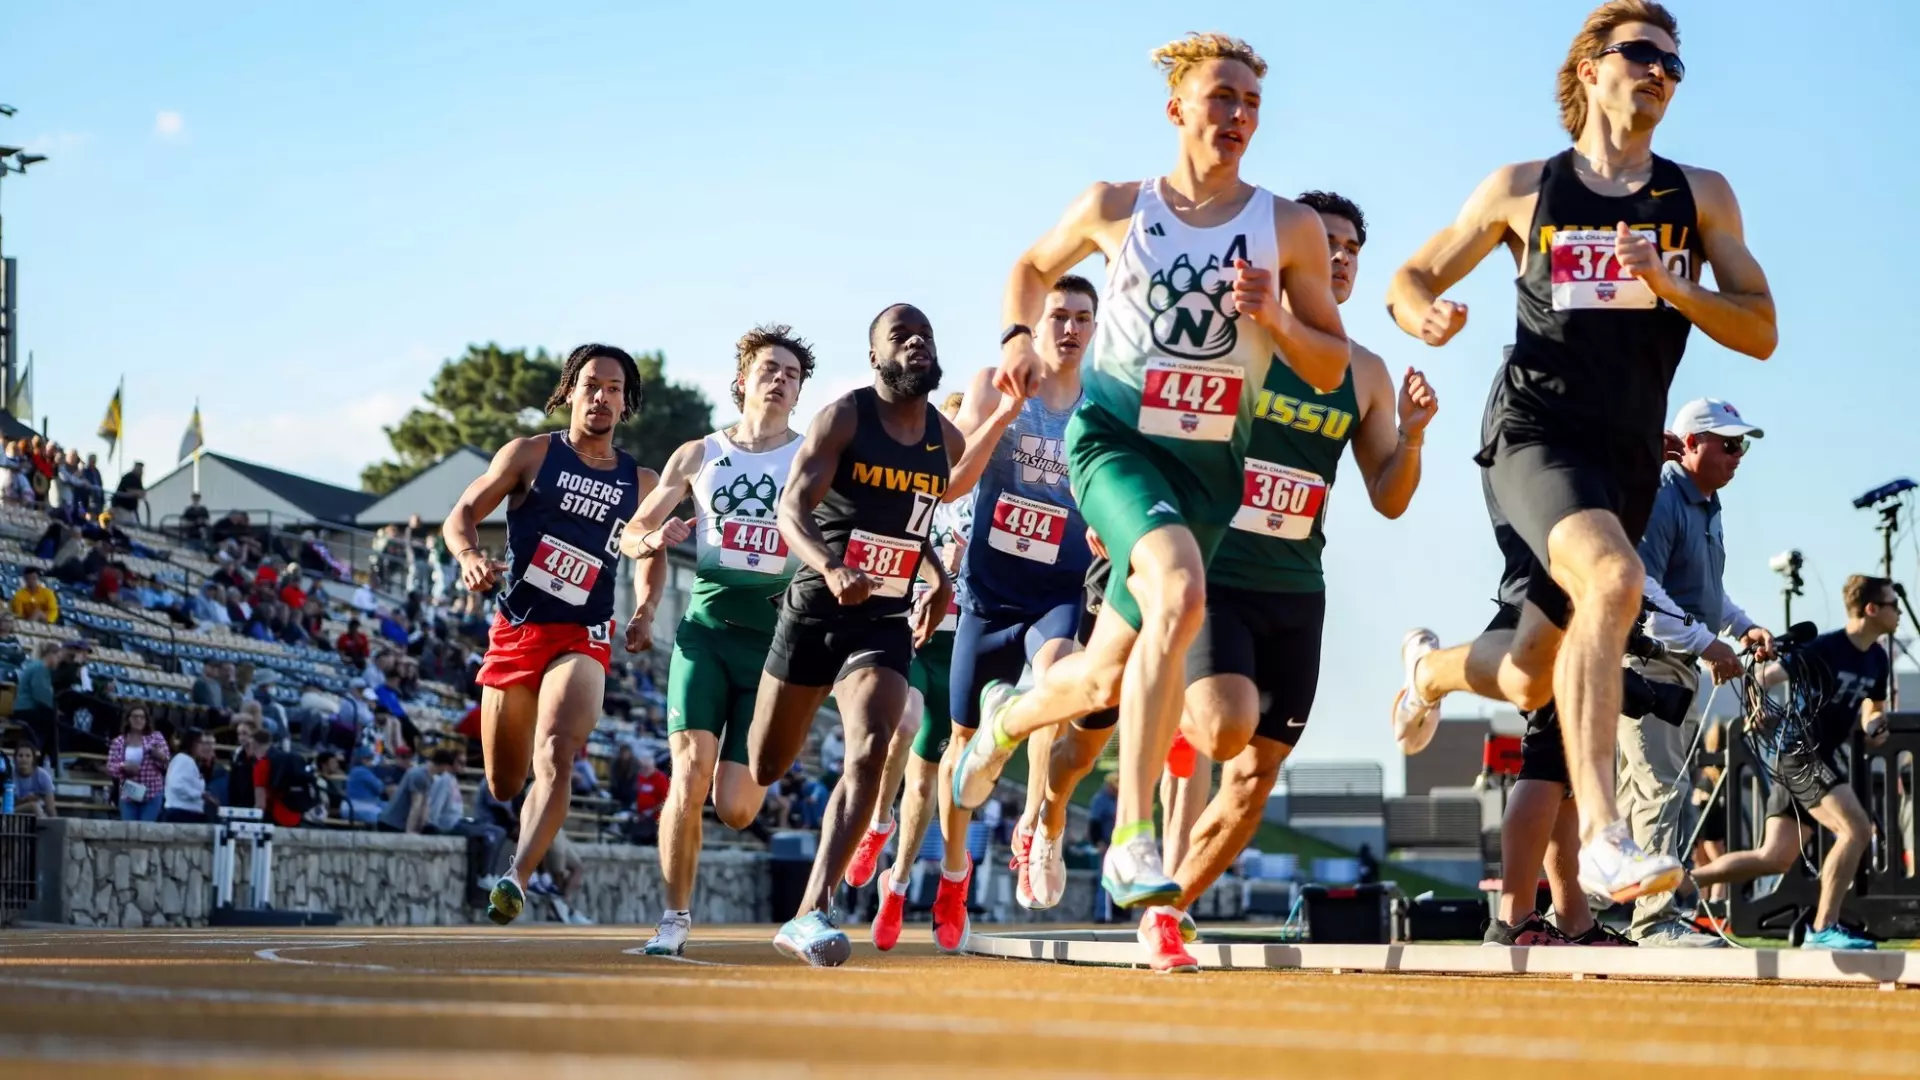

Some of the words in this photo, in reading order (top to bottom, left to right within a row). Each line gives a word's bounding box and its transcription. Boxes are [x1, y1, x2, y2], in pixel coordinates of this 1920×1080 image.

[1223, 234, 1252, 268] 4
[1572, 246, 1633, 280] 37
[1165, 307, 1214, 347] N
[1160, 372, 1226, 412] 442
[556, 470, 624, 505] ROGERS
[852, 462, 948, 497] MWSU
[1251, 474, 1310, 514] 360
[560, 492, 611, 522] STATE
[912, 495, 934, 532] 7
[1004, 507, 1053, 540] 494
[733, 525, 780, 554] 440
[543, 549, 589, 585] 480
[858, 543, 905, 576] 381
